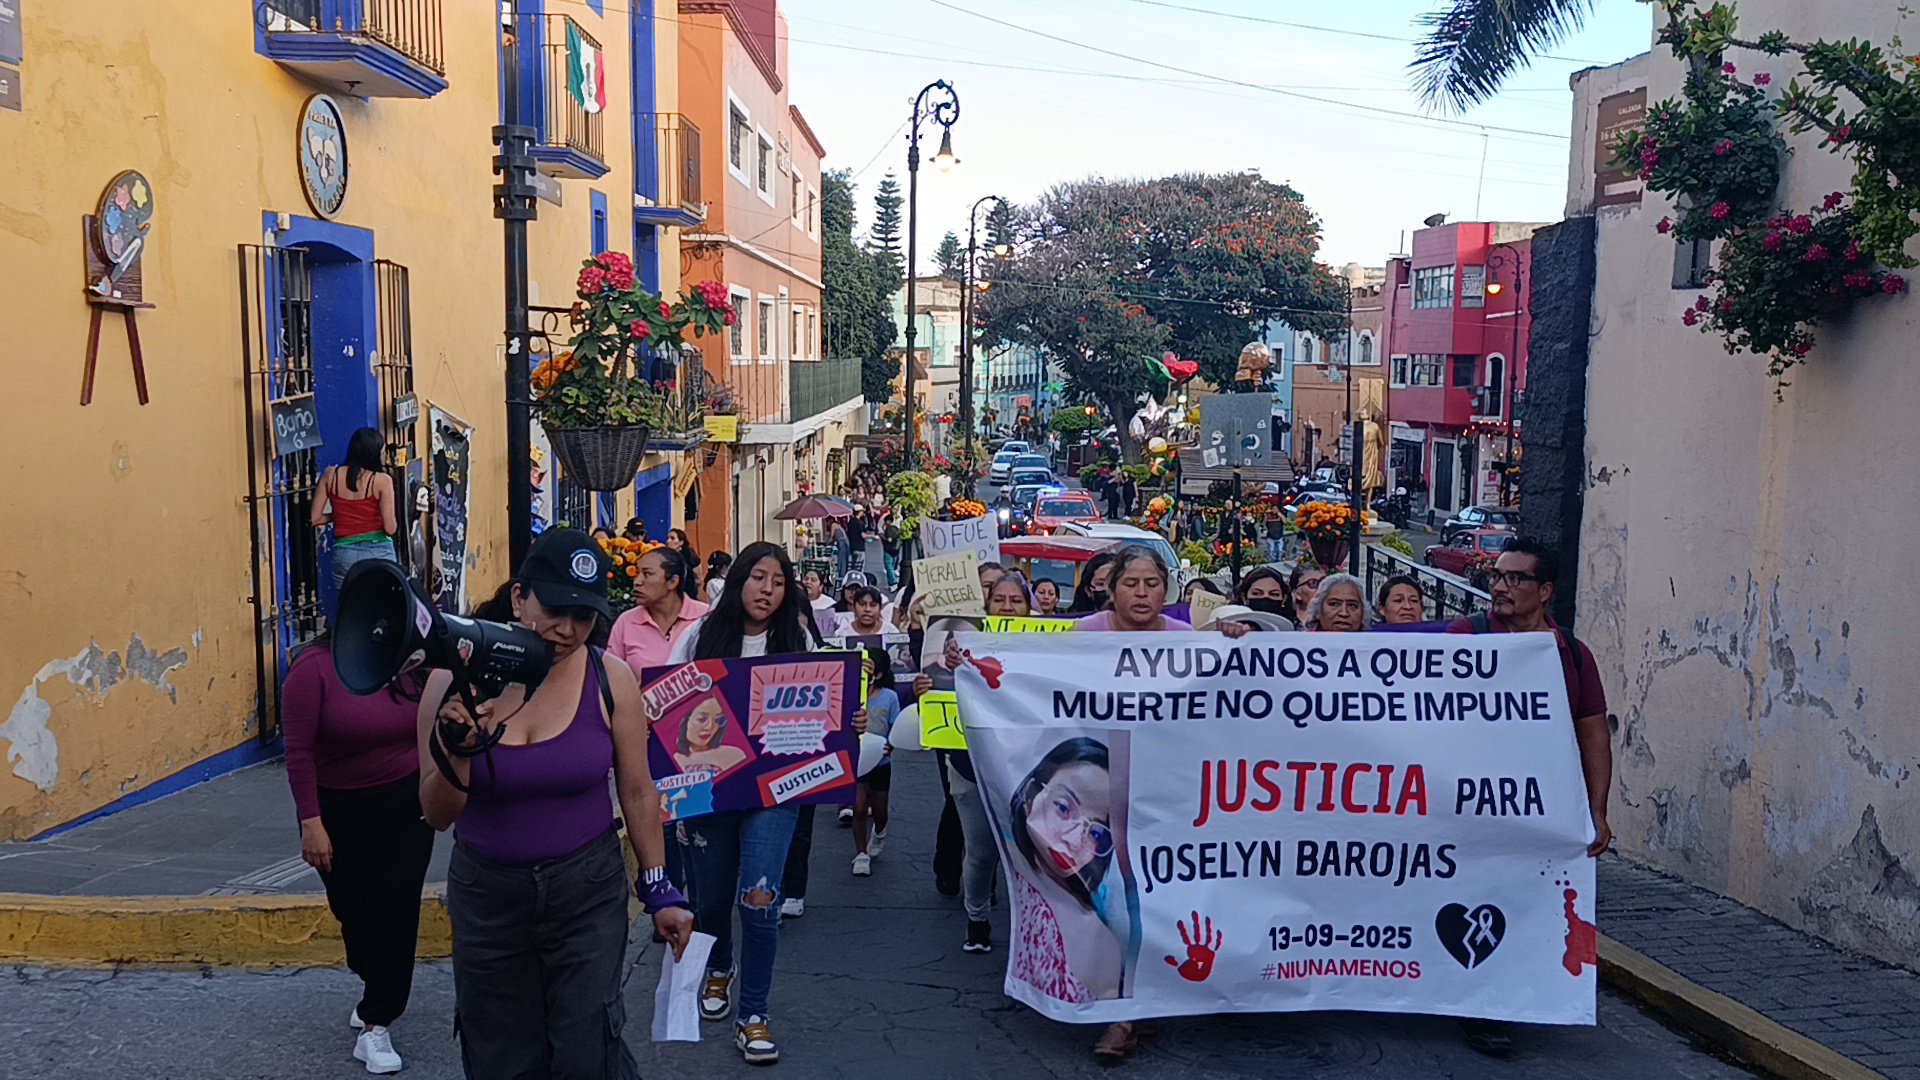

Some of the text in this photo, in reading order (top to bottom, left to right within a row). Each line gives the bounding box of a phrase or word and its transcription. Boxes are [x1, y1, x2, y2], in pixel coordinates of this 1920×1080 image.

[276, 408, 314, 438] Baño
[925, 521, 947, 550] NO
[1114, 647, 1498, 686] AYUDANOS A QUE SU
[651, 664, 699, 709] JUSTICE
[766, 685, 826, 710] JOSS
[1052, 689, 1551, 728] MUERTE NO QUEDE IMPUNE
[659, 772, 706, 789] JUSTICIA
[775, 762, 835, 796] JUSTICIA
[1192, 758, 1545, 828] JUSTICIA PARA
[1140, 840, 1457, 893] JOSELYN BAROJAS
[1268, 923, 1413, 951] 13-09-2025
[1260, 958, 1421, 981] #NIUNAMENOS
